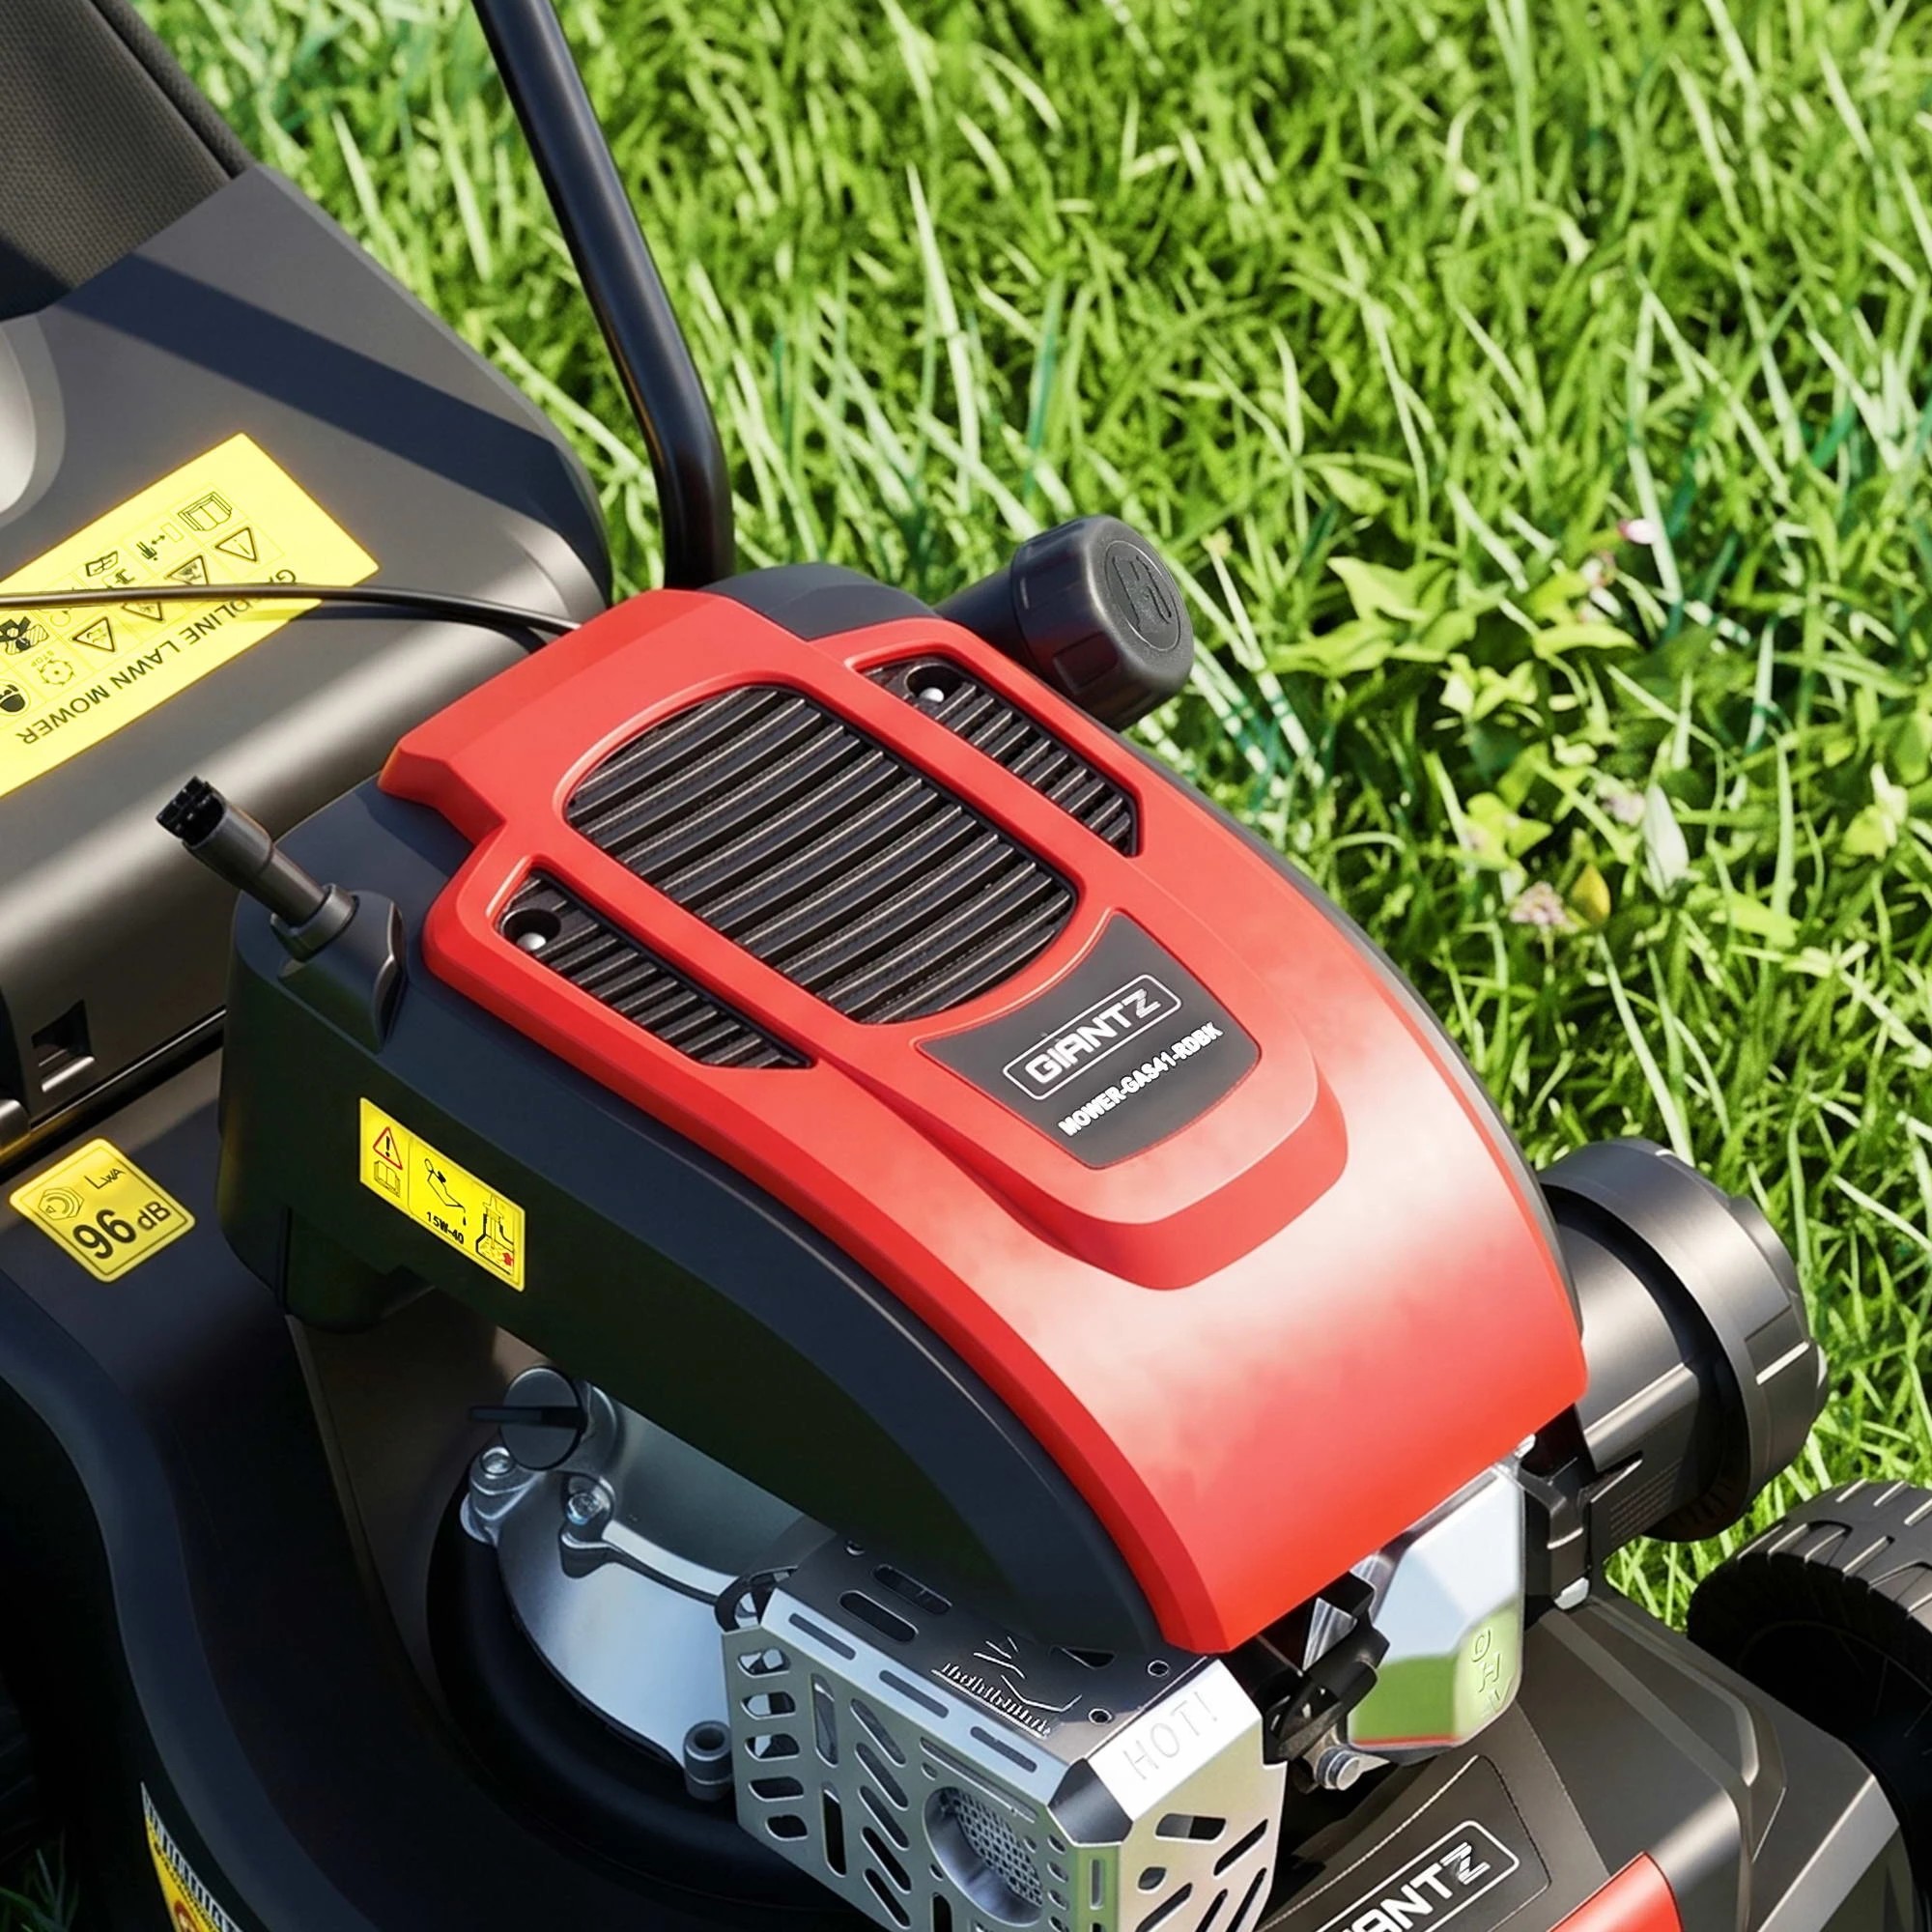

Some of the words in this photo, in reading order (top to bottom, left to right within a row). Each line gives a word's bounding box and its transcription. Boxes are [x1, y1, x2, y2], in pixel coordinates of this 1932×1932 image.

[179, 569, 297, 645] GOLINE
[110, 639, 181, 691] LAWN
[15, 684, 111, 745] MOWER
[1025, 988, 1161, 1084] GIANTZ
[1058, 1021, 1224, 1137] MOWER-GAS41-RDBK
[72, 1208, 137, 1260] 96
[137, 1201, 171, 1232] dB
[426, 1211, 464, 1245] 15W-40
[1122, 1691, 1217, 1779] HOT!
[1343, 1841, 1491, 1932] ANTZ
